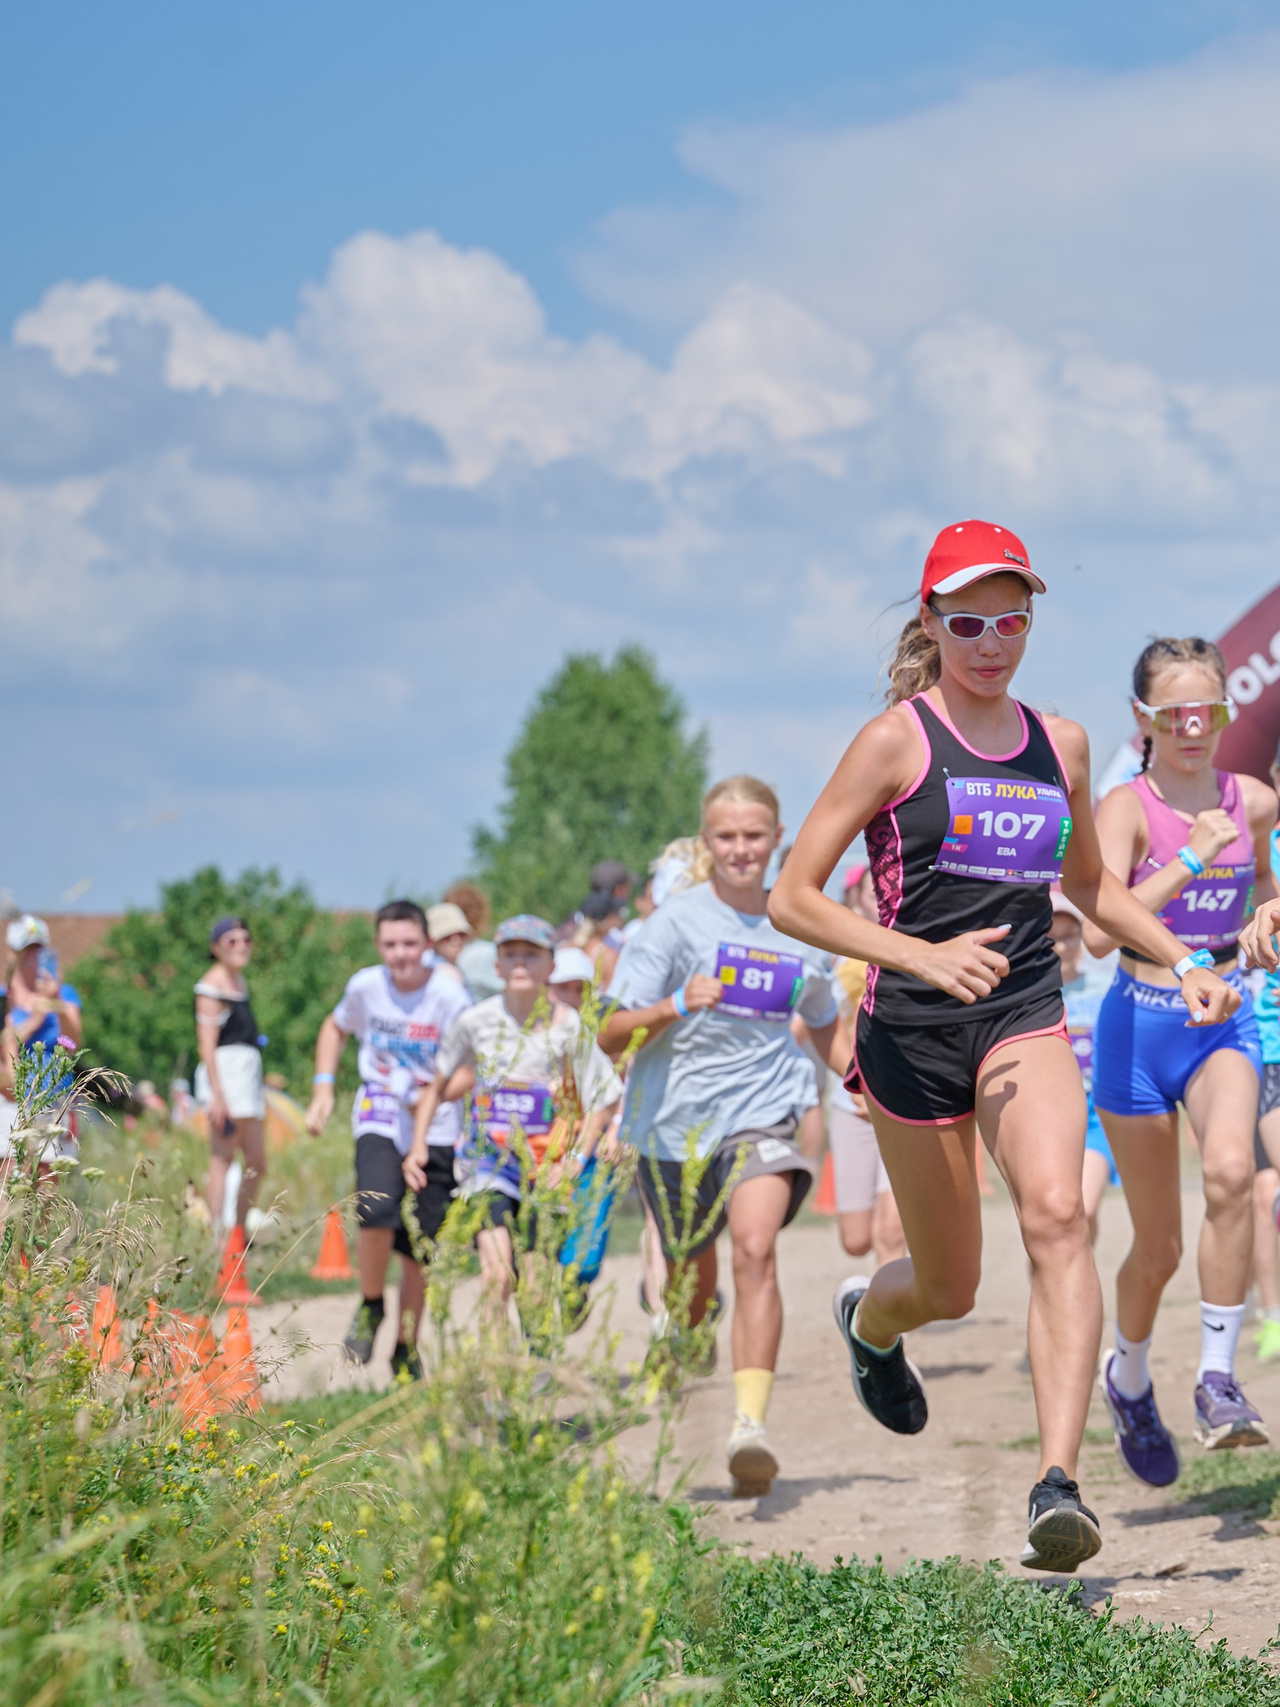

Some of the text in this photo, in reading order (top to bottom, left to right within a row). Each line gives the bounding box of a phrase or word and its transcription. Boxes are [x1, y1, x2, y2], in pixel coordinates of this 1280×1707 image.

[966, 782, 992, 796] ВТБ
[995, 784, 1037, 800] ЛУКА
[978, 810, 1046, 840] 107
[997, 846, 1016, 857] ЕВА
[1182, 888, 1238, 912] 147
[741, 967, 774, 992] 81
